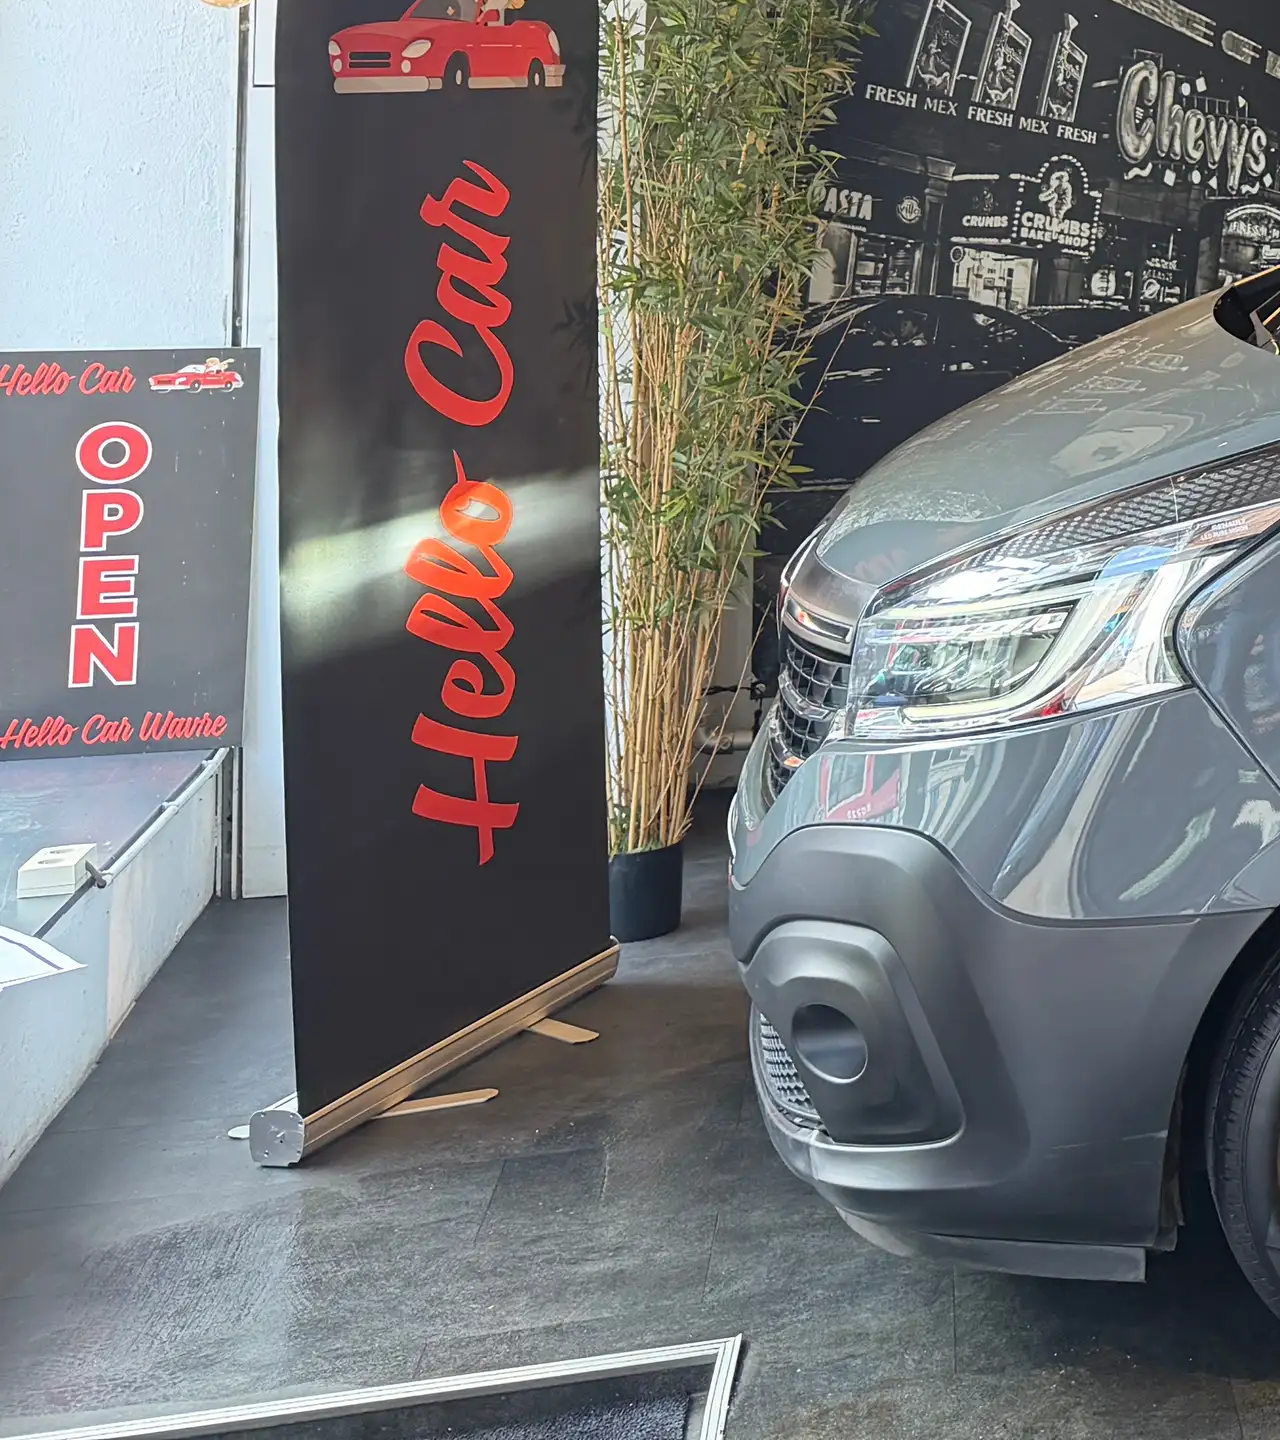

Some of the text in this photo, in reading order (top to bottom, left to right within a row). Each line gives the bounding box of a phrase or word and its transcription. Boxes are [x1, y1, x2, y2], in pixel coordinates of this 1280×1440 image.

[865, 84, 918, 108] FRESH
[924, 96, 959, 116] MEX
[967, 106, 1014, 128] FRESH
[1018, 116, 1049, 135] MEX
[1057, 124, 1098, 145] FRESH
[1116, 59, 1269, 196] Chevys
[823, 187, 873, 221] ASTA
[962, 215, 1009, 228] CRUMBS
[1021, 211, 1092, 237] CRUMBS
[0, 362, 136, 396] Hello Car
[404, 160, 519, 865] Hello Car
[68, 421, 152, 688] OPEN
[0, 710, 227, 749] Hello Car Wavre
